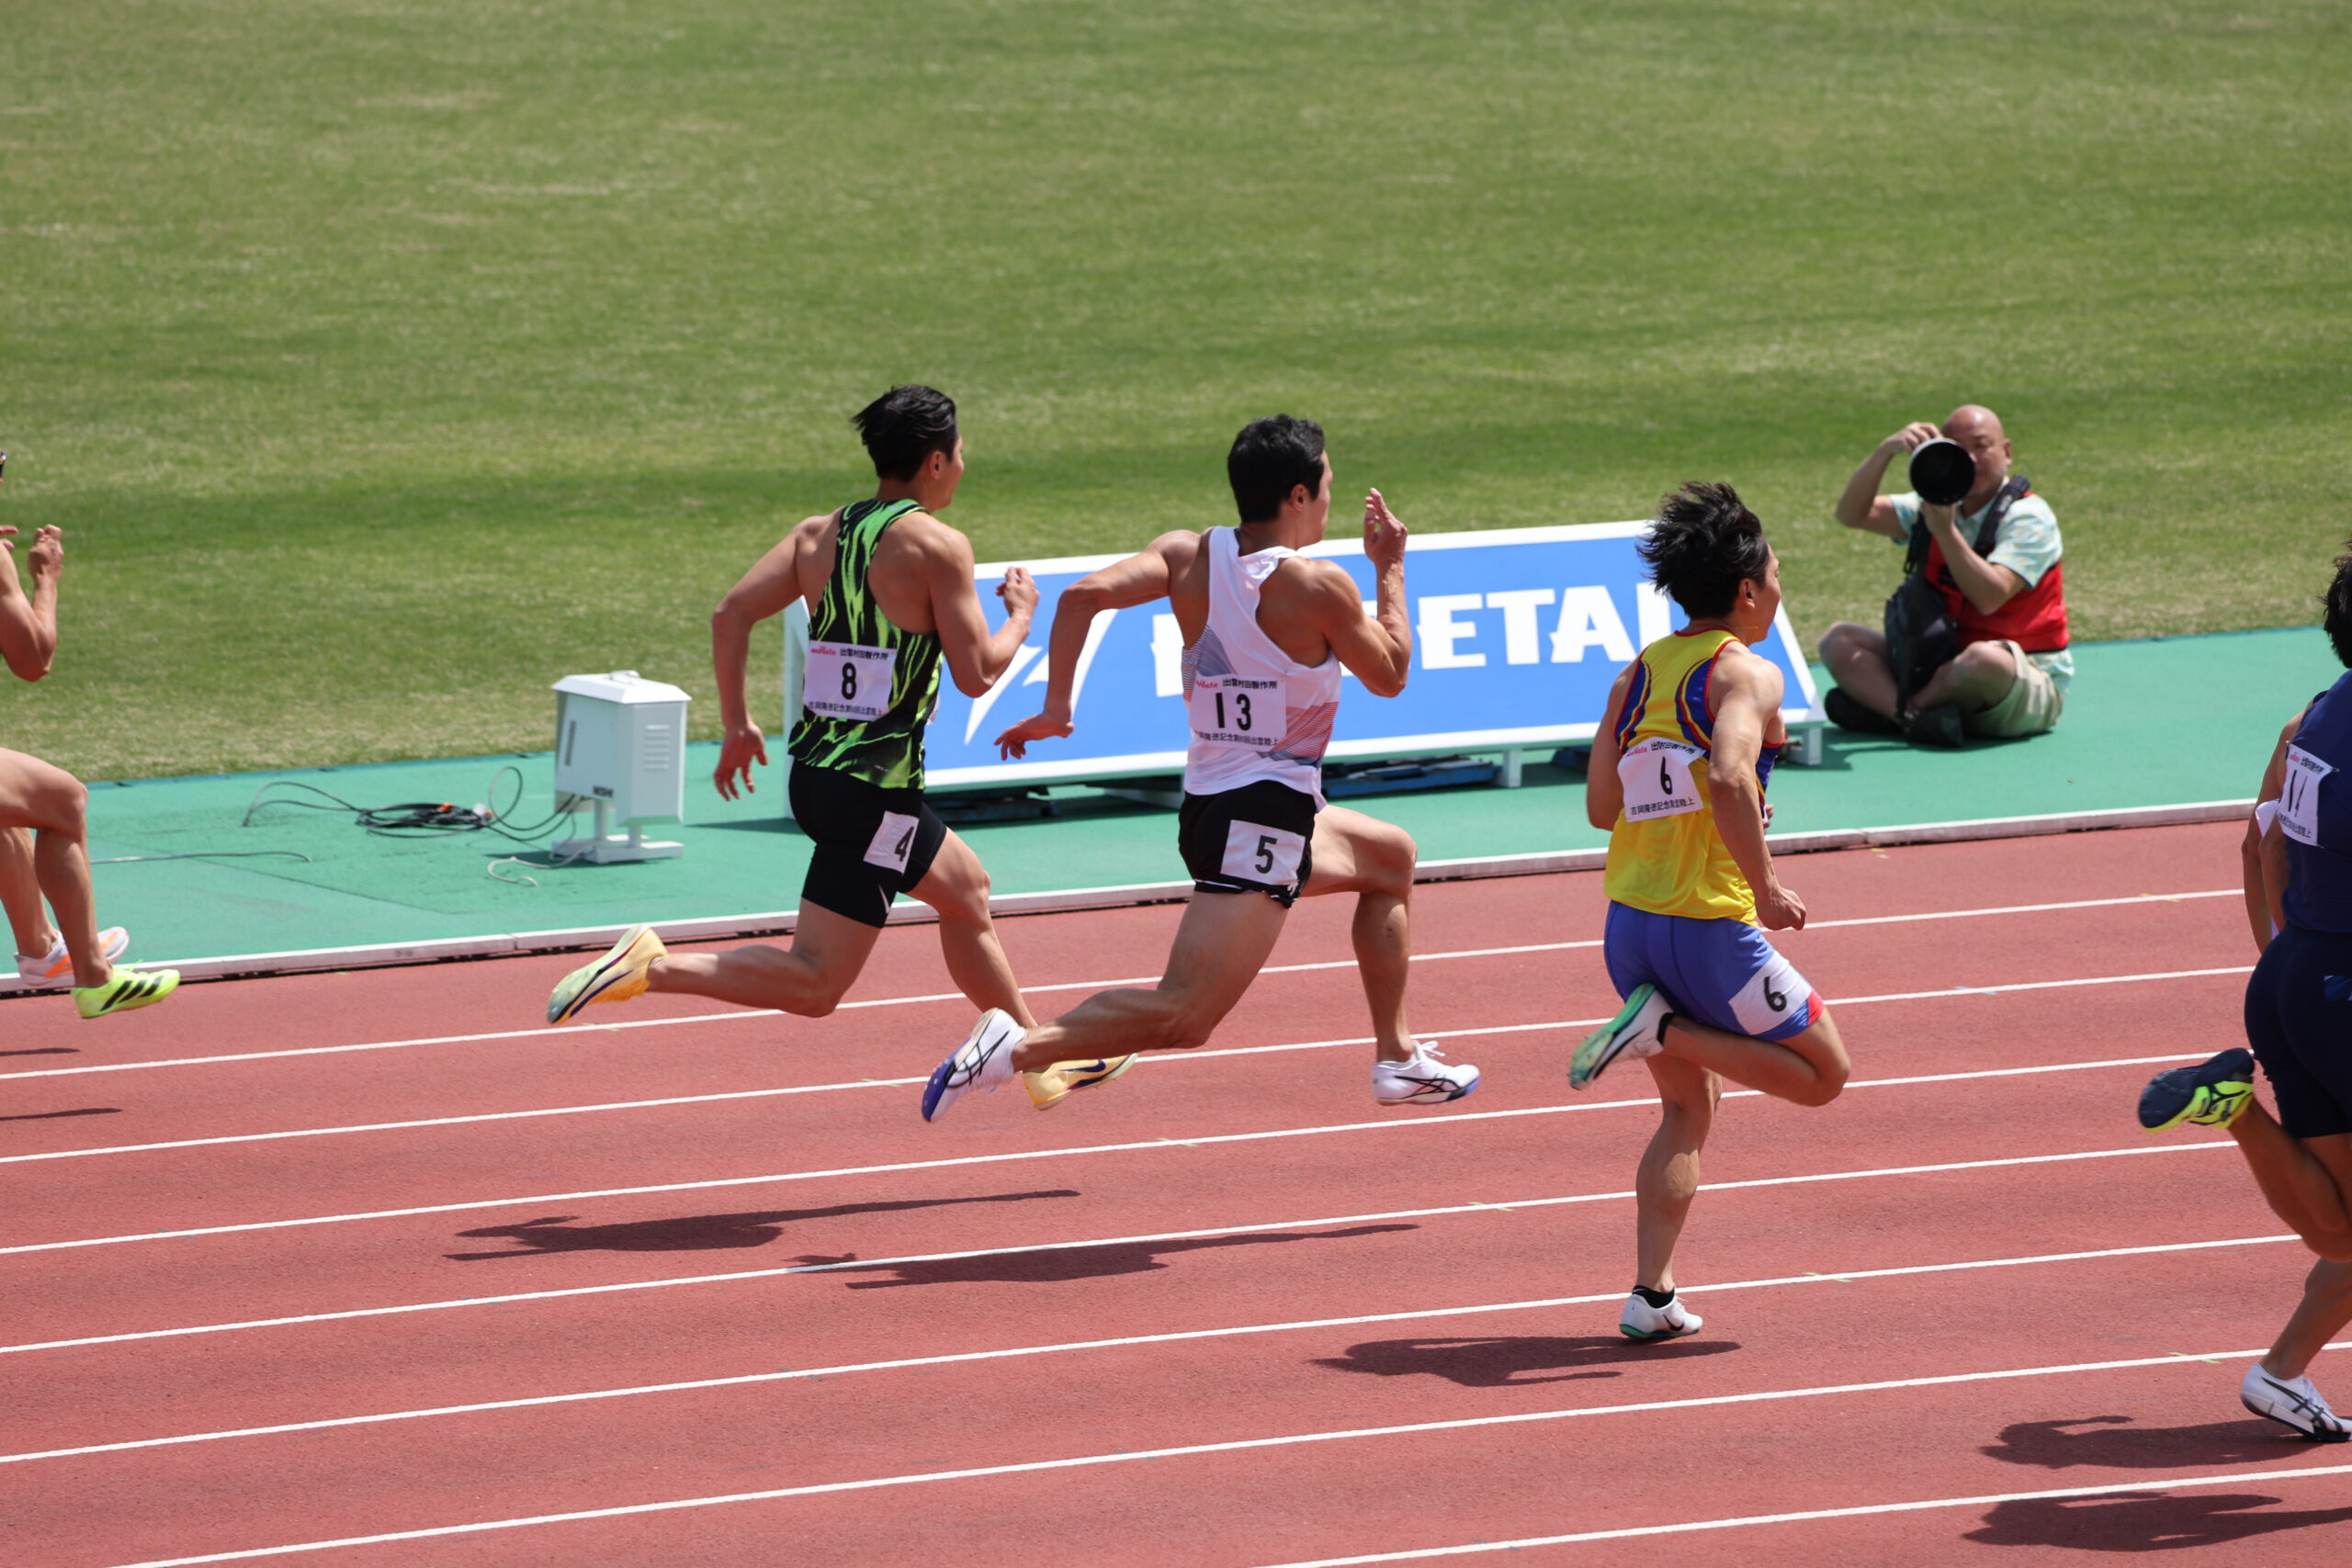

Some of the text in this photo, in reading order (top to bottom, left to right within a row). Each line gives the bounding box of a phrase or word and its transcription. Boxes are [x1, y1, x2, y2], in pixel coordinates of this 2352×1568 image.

[840, 648, 889, 660] 出雲村田製作所
[841, 662, 857, 700] 8
[1223, 678, 1278, 690] 出雲村田製作所
[1215, 692, 1252, 731] 13
[1660, 756, 1673, 795] 6
[894, 826, 915, 863] 4
[1255, 835, 1278, 874] 5
[1764, 976, 1787, 1012] 6
